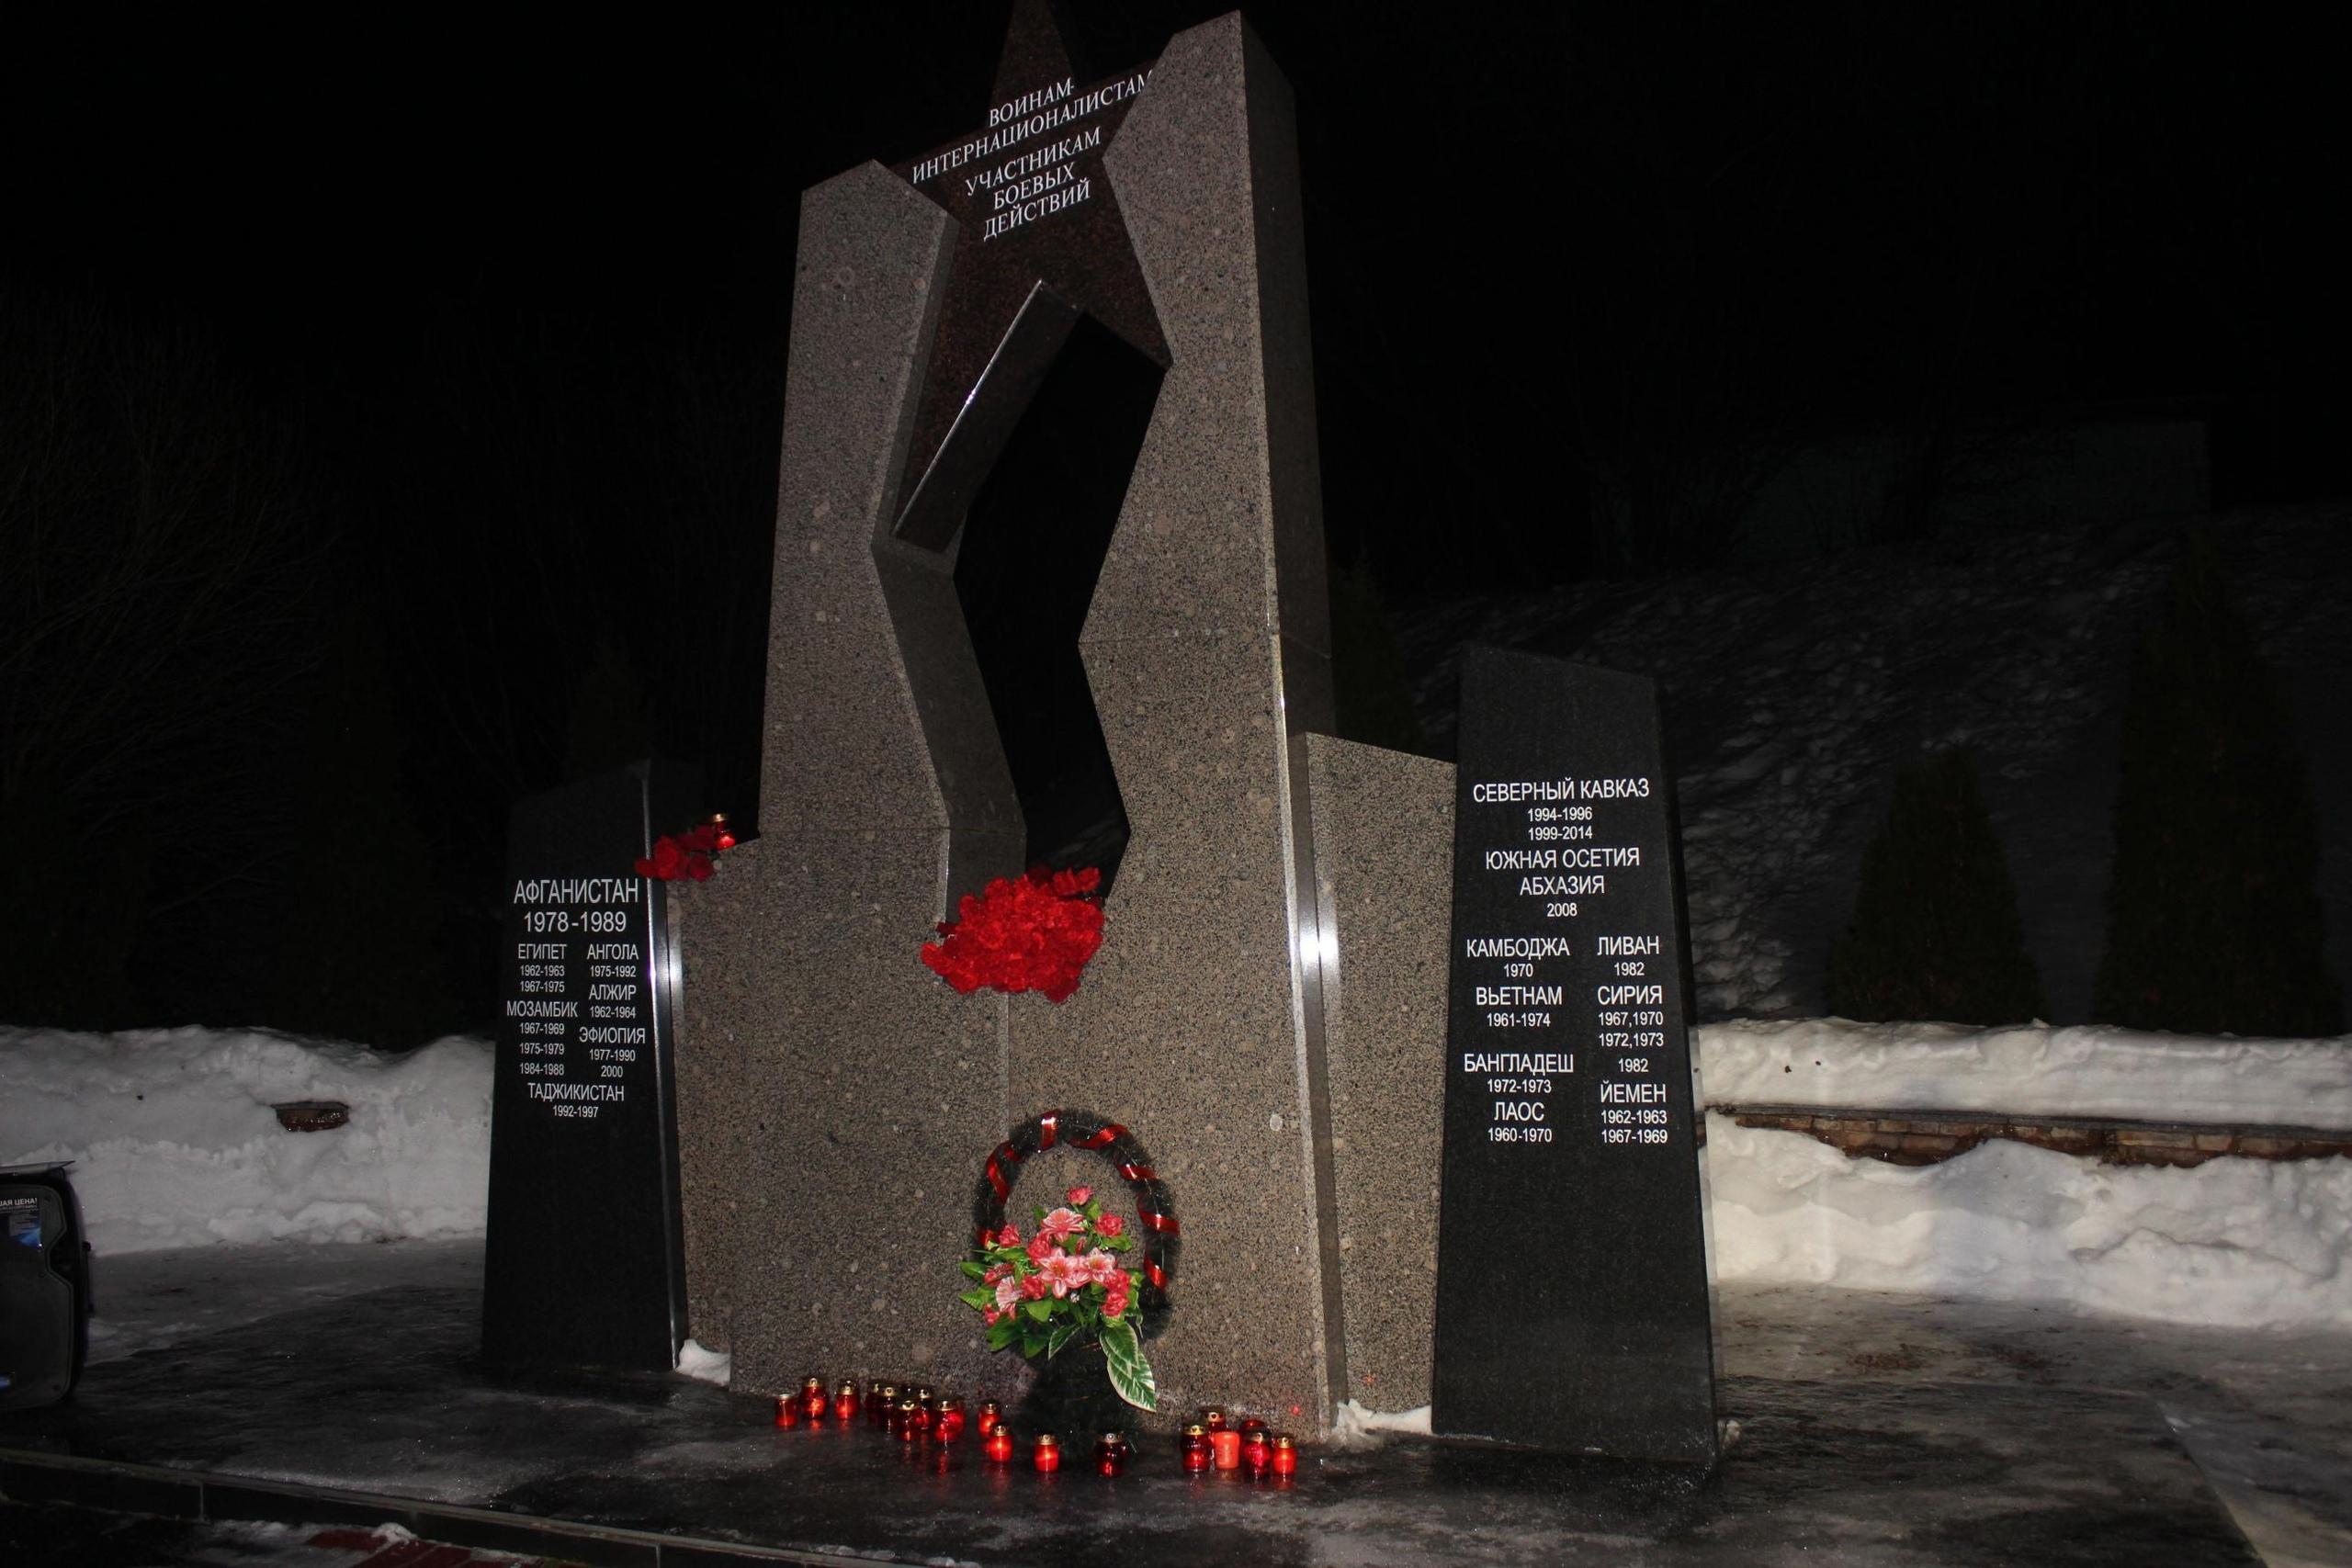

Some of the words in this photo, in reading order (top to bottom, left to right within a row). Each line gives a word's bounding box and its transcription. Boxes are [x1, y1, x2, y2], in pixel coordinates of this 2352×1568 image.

[965, 127, 1101, 196] УЧАСТНИКАМ
[993, 163, 1075, 209] БОЕВЫХ
[983, 177, 1091, 242] ДЕЙСТВИЙ
[1474, 778, 1574, 802] СЕВЕРНЫЙ
[1581, 778, 1649, 799] КАВКАЗ
[1528, 807, 1592, 821] 1994-1996
[1529, 826, 1592, 840] 1999-2014
[1487, 850, 1556, 870] ЮЖНАЯ
[1563, 848, 1639, 868] ОСЕТИЯ
[514, 878, 638, 904] АФГАНИСТАН
[1520, 875, 1604, 896] АБХАЗИЯ
[1547, 903, 1577, 917] 2008
[518, 943, 567, 959] ЕГИПЕТ
[587, 944, 639, 960] АНГОЛА
[1467, 938, 1570, 960] КАМБОДЖА
[1597, 936, 1659, 955] ЛИВАН
[520, 964, 565, 976] 1962-1963
[591, 965, 636, 977] 1975-1992
[1504, 964, 1533, 977] 1970
[1614, 962, 1645, 976] 1982
[520, 981, 564, 992] 1967-1975
[589, 985, 636, 1000] АЛЖИР
[1476, 987, 1562, 1005] ВЬЕТНАМ
[1598, 986, 1662, 1005] СИРИЯ
[507, 1000, 578, 1017] МОЗАМБИК
[590, 1006, 636, 1018] 1962-1964
[1487, 1013, 1551, 1027] 1961-1974
[1599, 1011, 1663, 1028] 1967,1970
[520, 1022, 564, 1034] 1967-1969
[580, 1027, 645, 1043] ЭФИОПИЯ
[1599, 1032, 1664, 1048] 1972,1973
[520, 1043, 564, 1055] 1975-1979
[590, 1049, 636, 1061] 1977-1990
[520, 1063, 564, 1076] 1984-1988
[601, 1066, 623, 1077] 2000
[1464, 1054, 1573, 1076] БАНГЛАДЕШ
[1619, 1058, 1648, 1072] 1982
[527, 1083, 624, 1101] ТАДЖИКИСТАН
[1487, 1078, 1552, 1093] 1972-1973
[1600, 1080, 1666, 1102] ЙЕМЕН
[553, 1105, 598, 1117] 1992-1997
[1494, 1102, 1544, 1121] ЛАОС
[1601, 1110, 1667, 1123] 1962-1963
[1488, 1128, 1552, 1142] 1960-1970
[1601, 1129, 1668, 1144] 1967-1969
